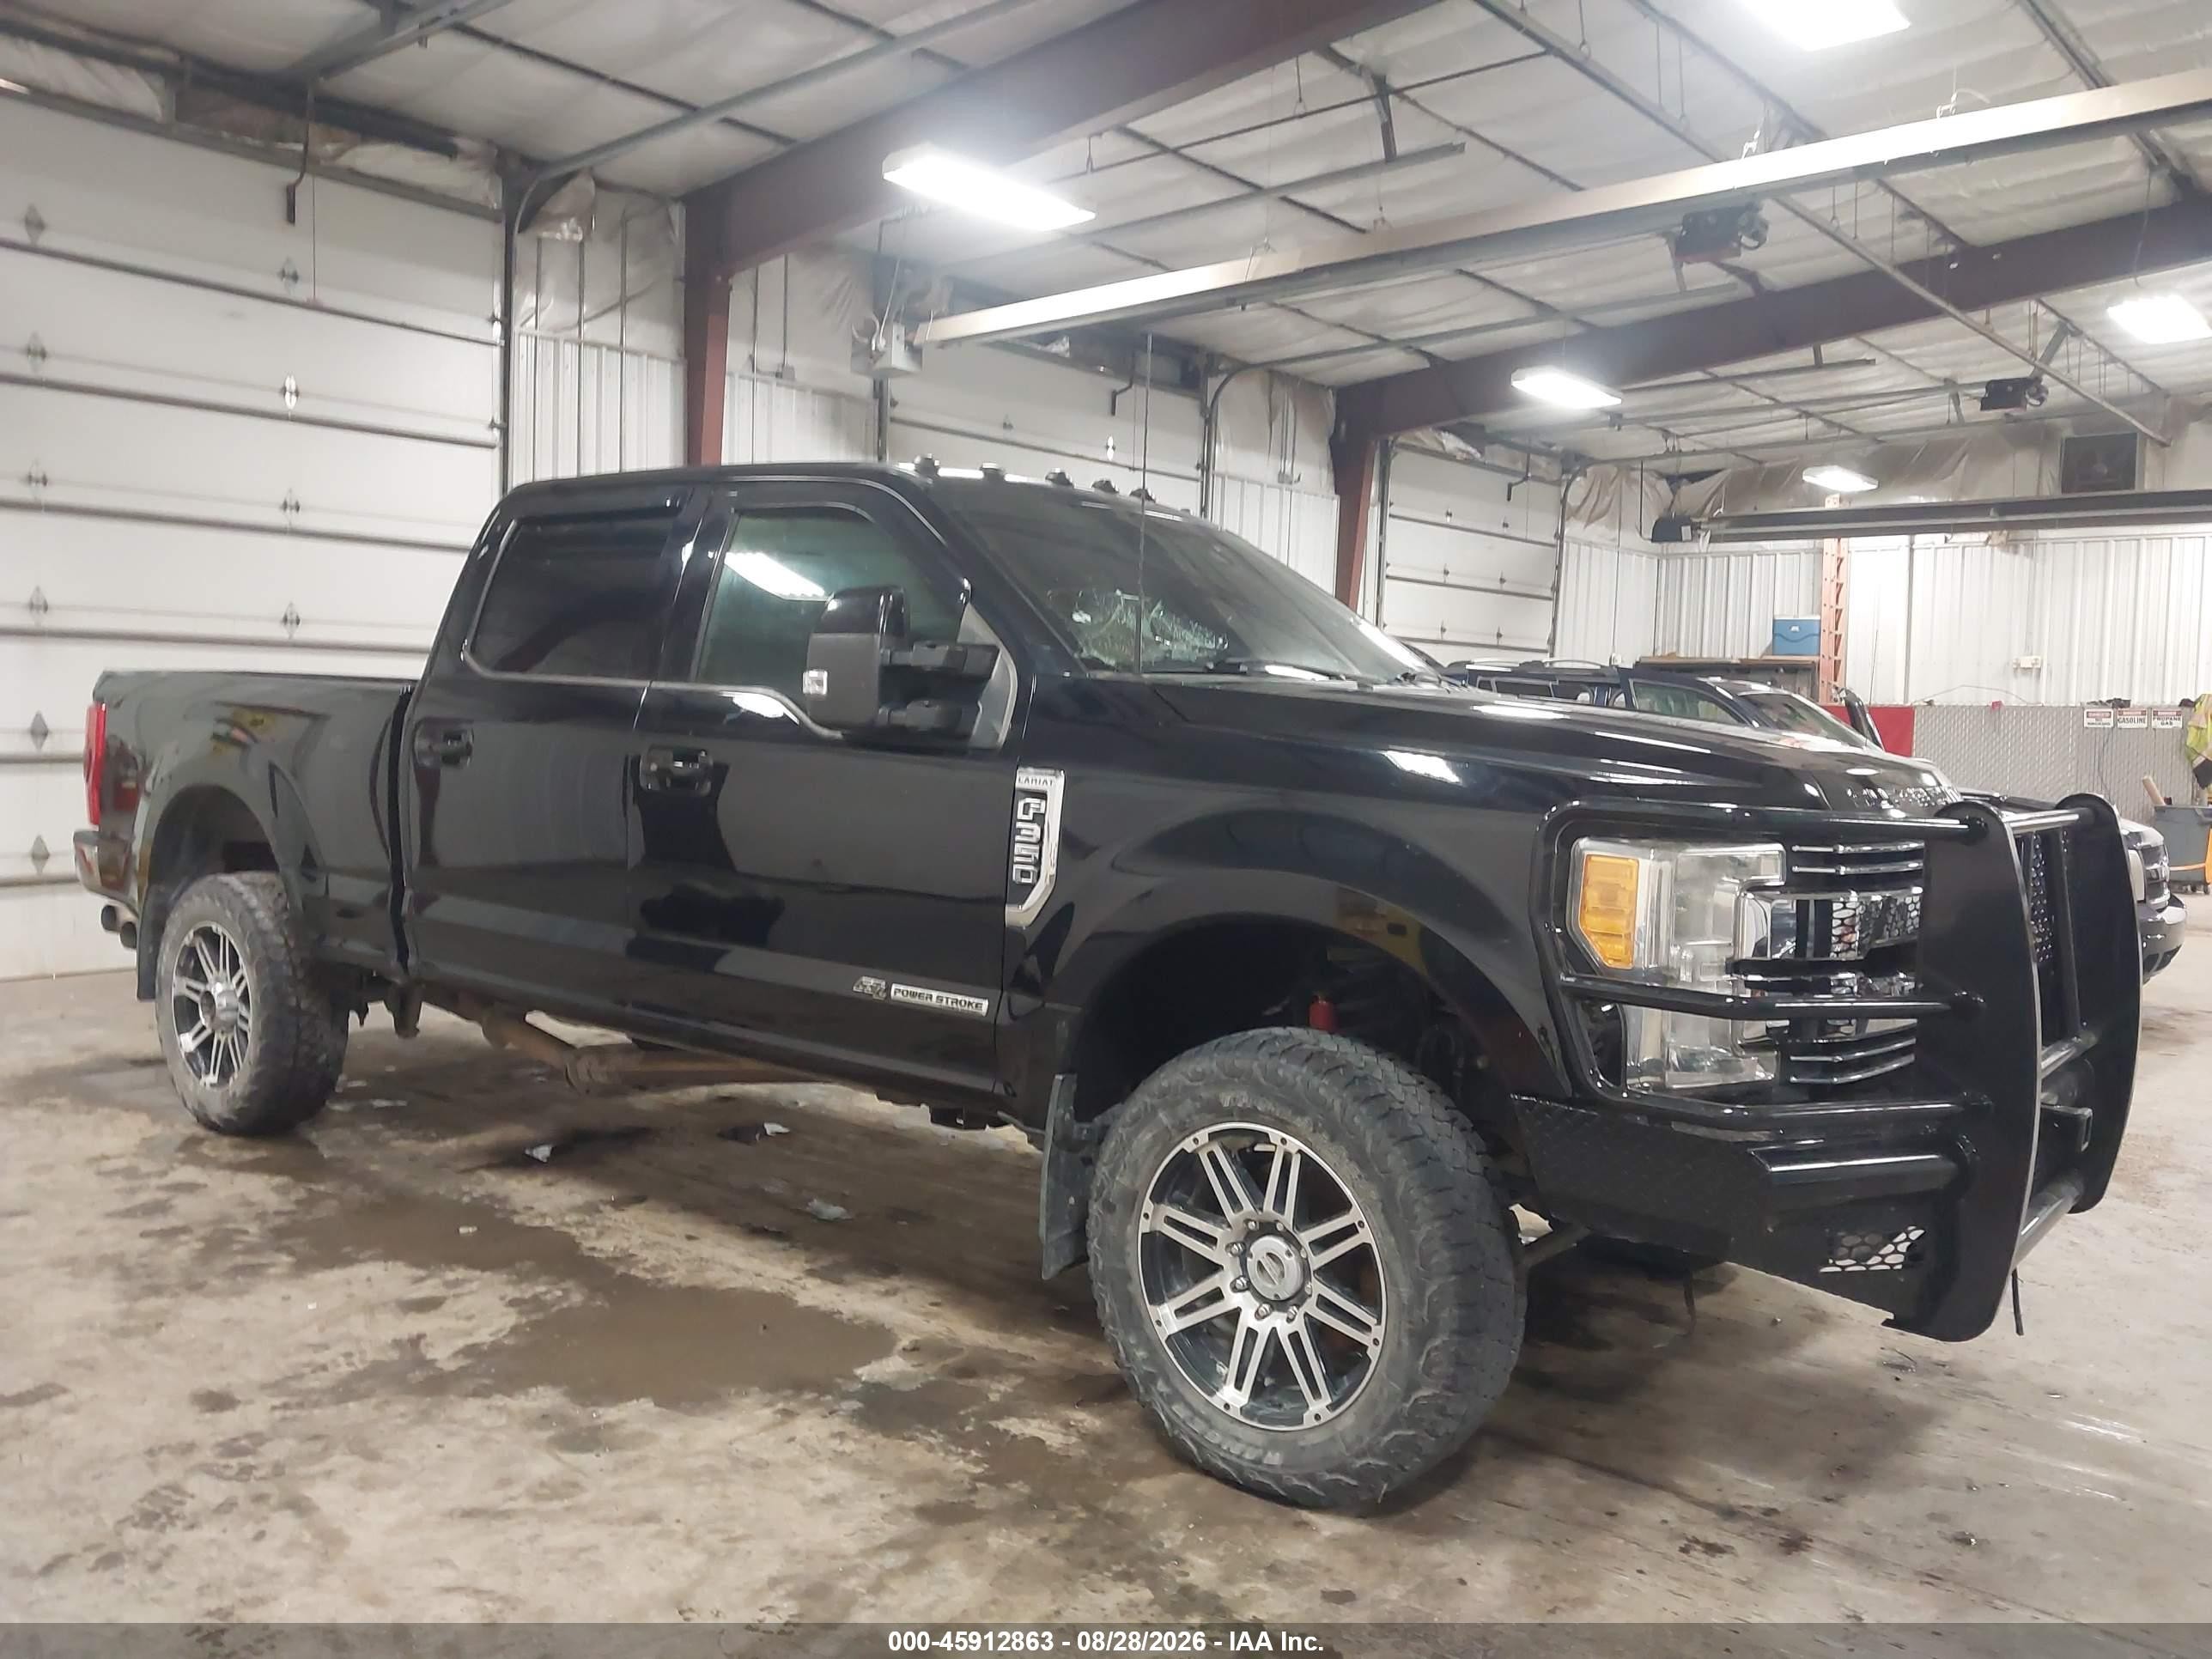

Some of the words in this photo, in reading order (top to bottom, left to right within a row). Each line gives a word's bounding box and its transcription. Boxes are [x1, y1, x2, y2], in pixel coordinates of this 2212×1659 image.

[2118, 716, 2146, 725] GASOLINE
[1018, 775, 1054, 787] LARIAT
[894, 988, 934, 1002] POWER
[935, 996, 984, 1010] STROKE
